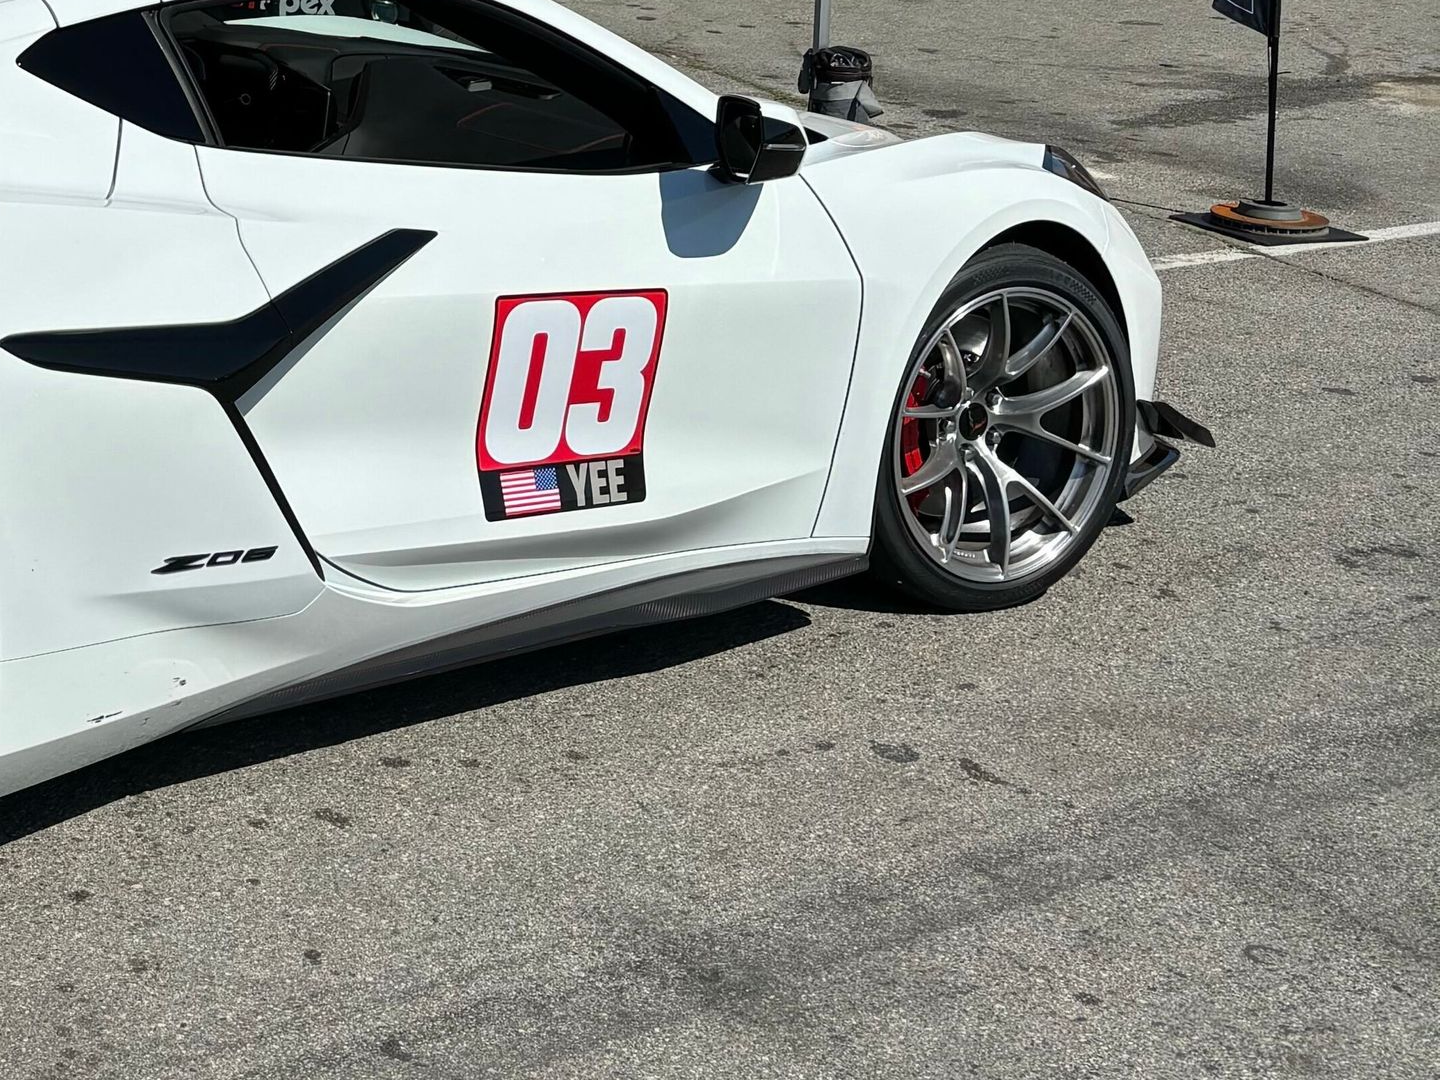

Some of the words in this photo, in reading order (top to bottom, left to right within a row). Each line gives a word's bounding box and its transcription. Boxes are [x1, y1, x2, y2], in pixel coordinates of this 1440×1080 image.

[484, 296, 658, 465] 03
[564, 458, 628, 507] YEE
[151, 545, 279, 575] Z06
